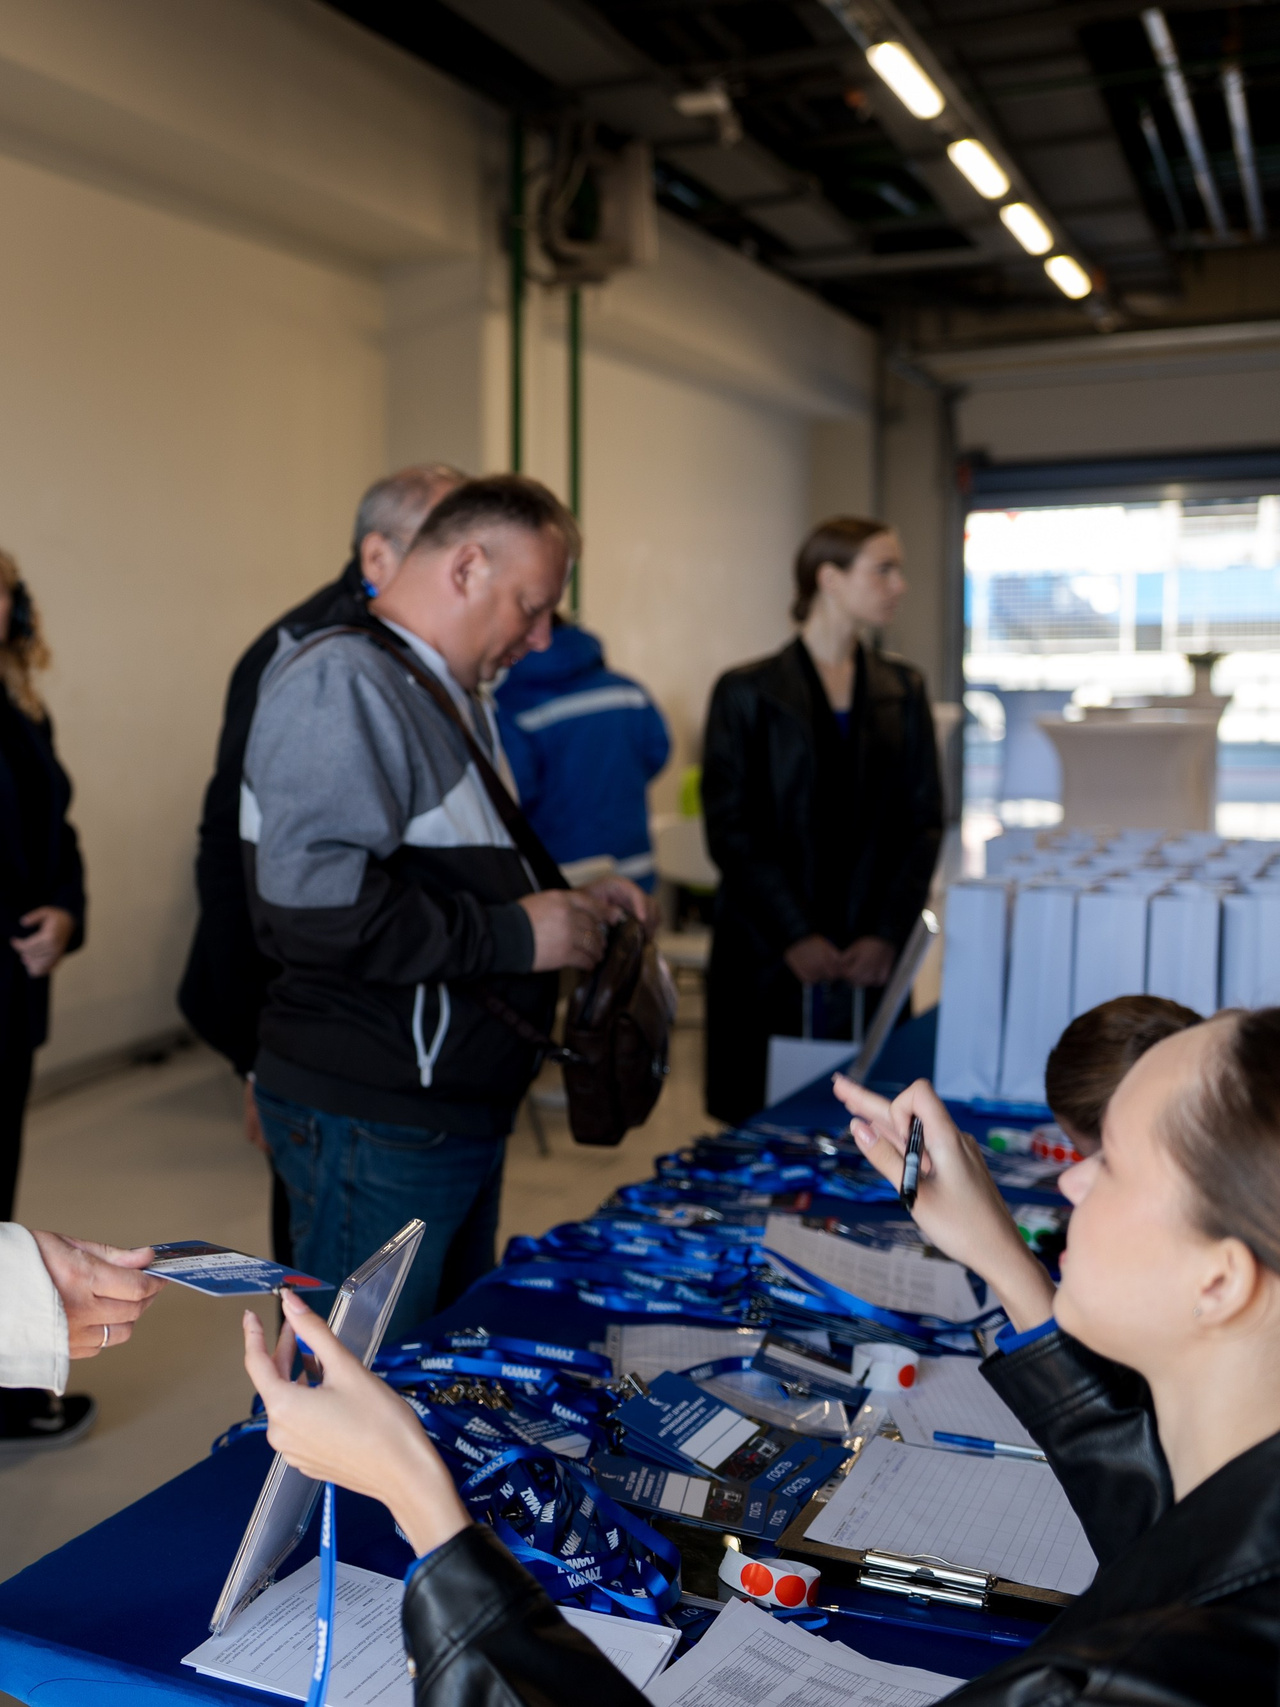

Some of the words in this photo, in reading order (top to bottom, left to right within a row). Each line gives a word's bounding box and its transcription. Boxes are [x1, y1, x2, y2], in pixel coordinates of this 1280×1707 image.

[535, 1344, 576, 1363] KAMAZ
[501, 1363, 542, 1382] KAMAZ
[454, 1436, 485, 1464] KAMAZ
[468, 1456, 507, 1487] KAMAZ
[766, 1461, 793, 1482] ГОСТЬ
[782, 1477, 811, 1497] ГОСТЬ
[748, 1501, 763, 1519] ГОСТЬ
[769, 1509, 787, 1527] ГОСТЬ
[567, 1566, 603, 1588] KAMAZ
[314, 1618, 329, 1682] KAMAZ
